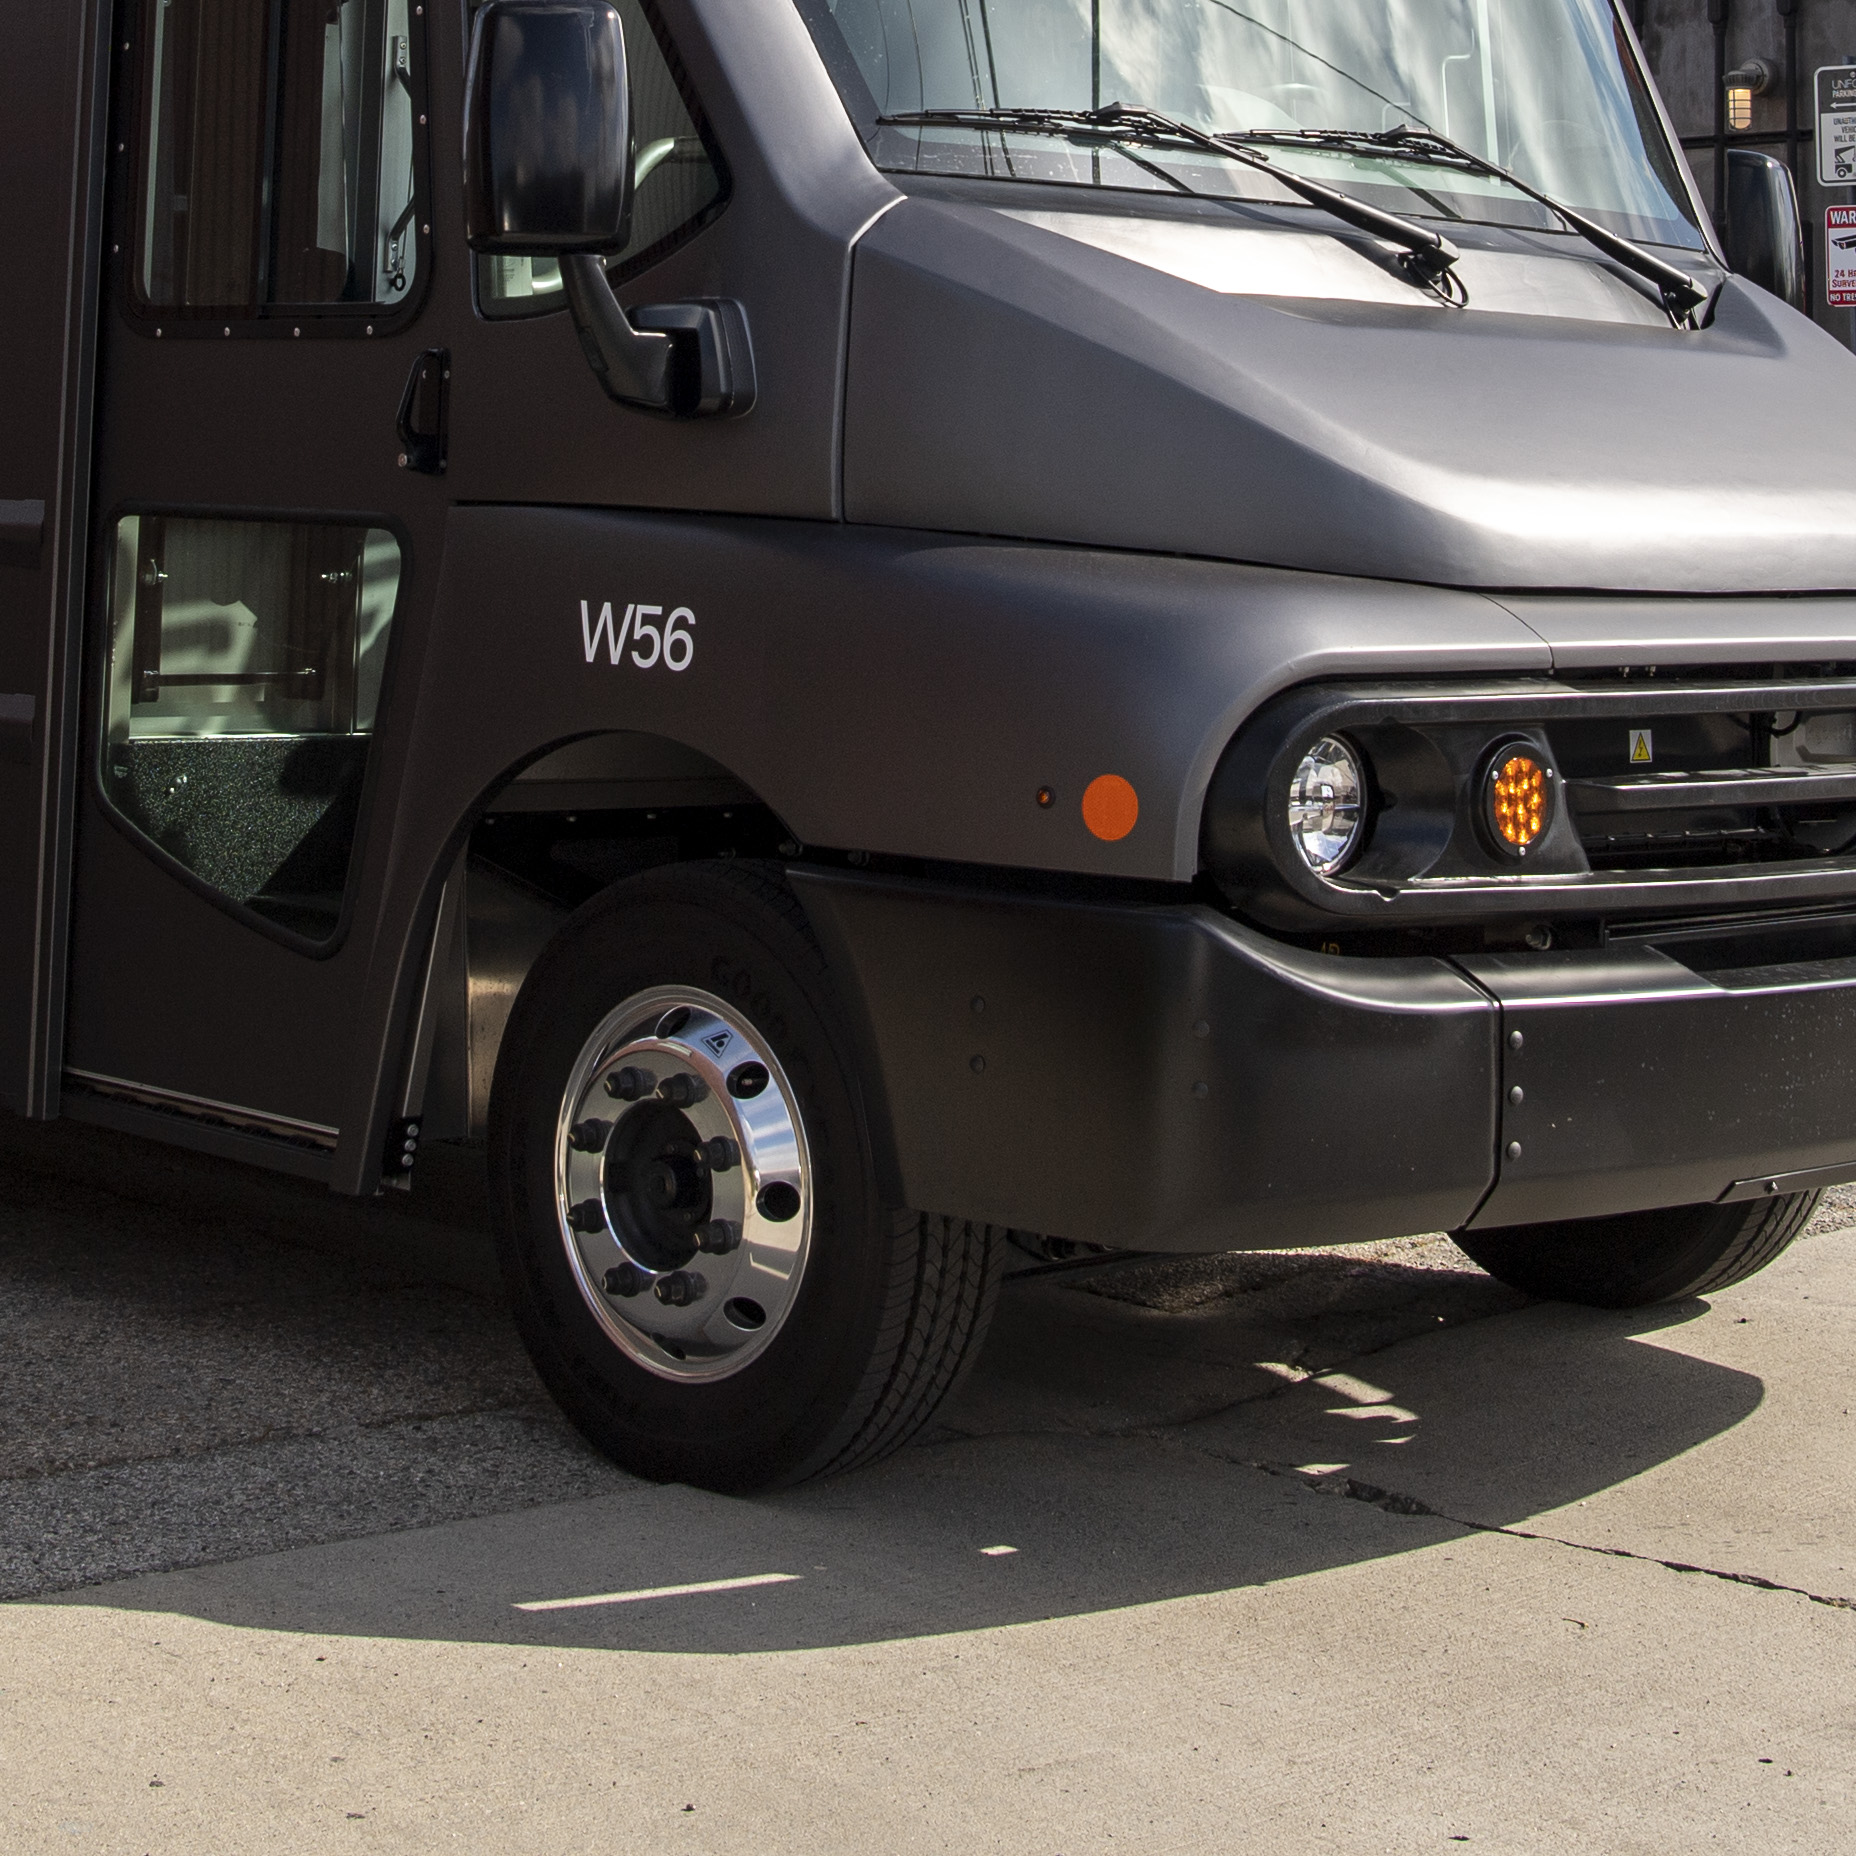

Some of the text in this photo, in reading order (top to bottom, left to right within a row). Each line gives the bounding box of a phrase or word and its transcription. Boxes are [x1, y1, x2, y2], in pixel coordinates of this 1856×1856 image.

[1833, 134, 1848, 143] WILL
[1848, 134, 1856, 143] BE
[1834, 269, 1846, 279] 24
[1829, 293, 1841, 302] NO
[580, 599, 696, 672] W56
